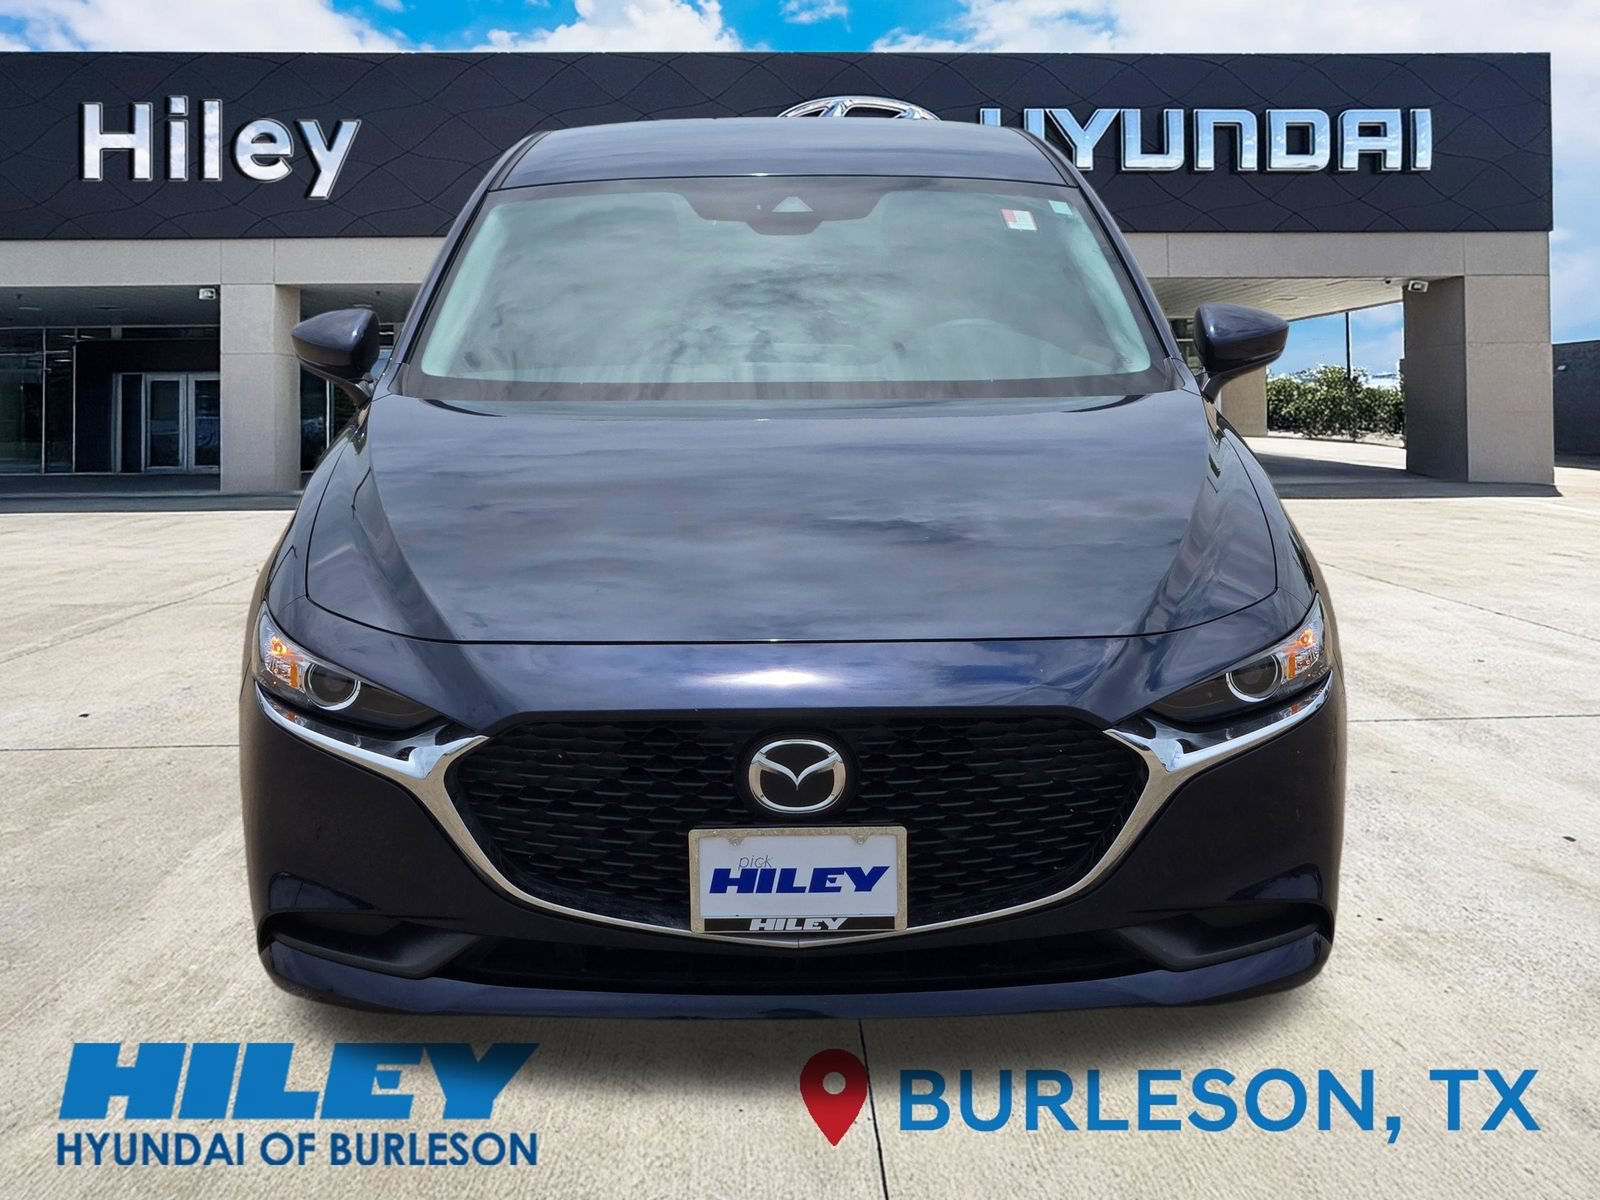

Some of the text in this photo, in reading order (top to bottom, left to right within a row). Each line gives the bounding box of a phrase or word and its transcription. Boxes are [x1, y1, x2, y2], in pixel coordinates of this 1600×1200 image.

[80, 96, 362, 201] Hiley
[738, 855, 774, 870] pick
[709, 866, 890, 894] HILEY
[749, 917, 848, 931] HILEY
